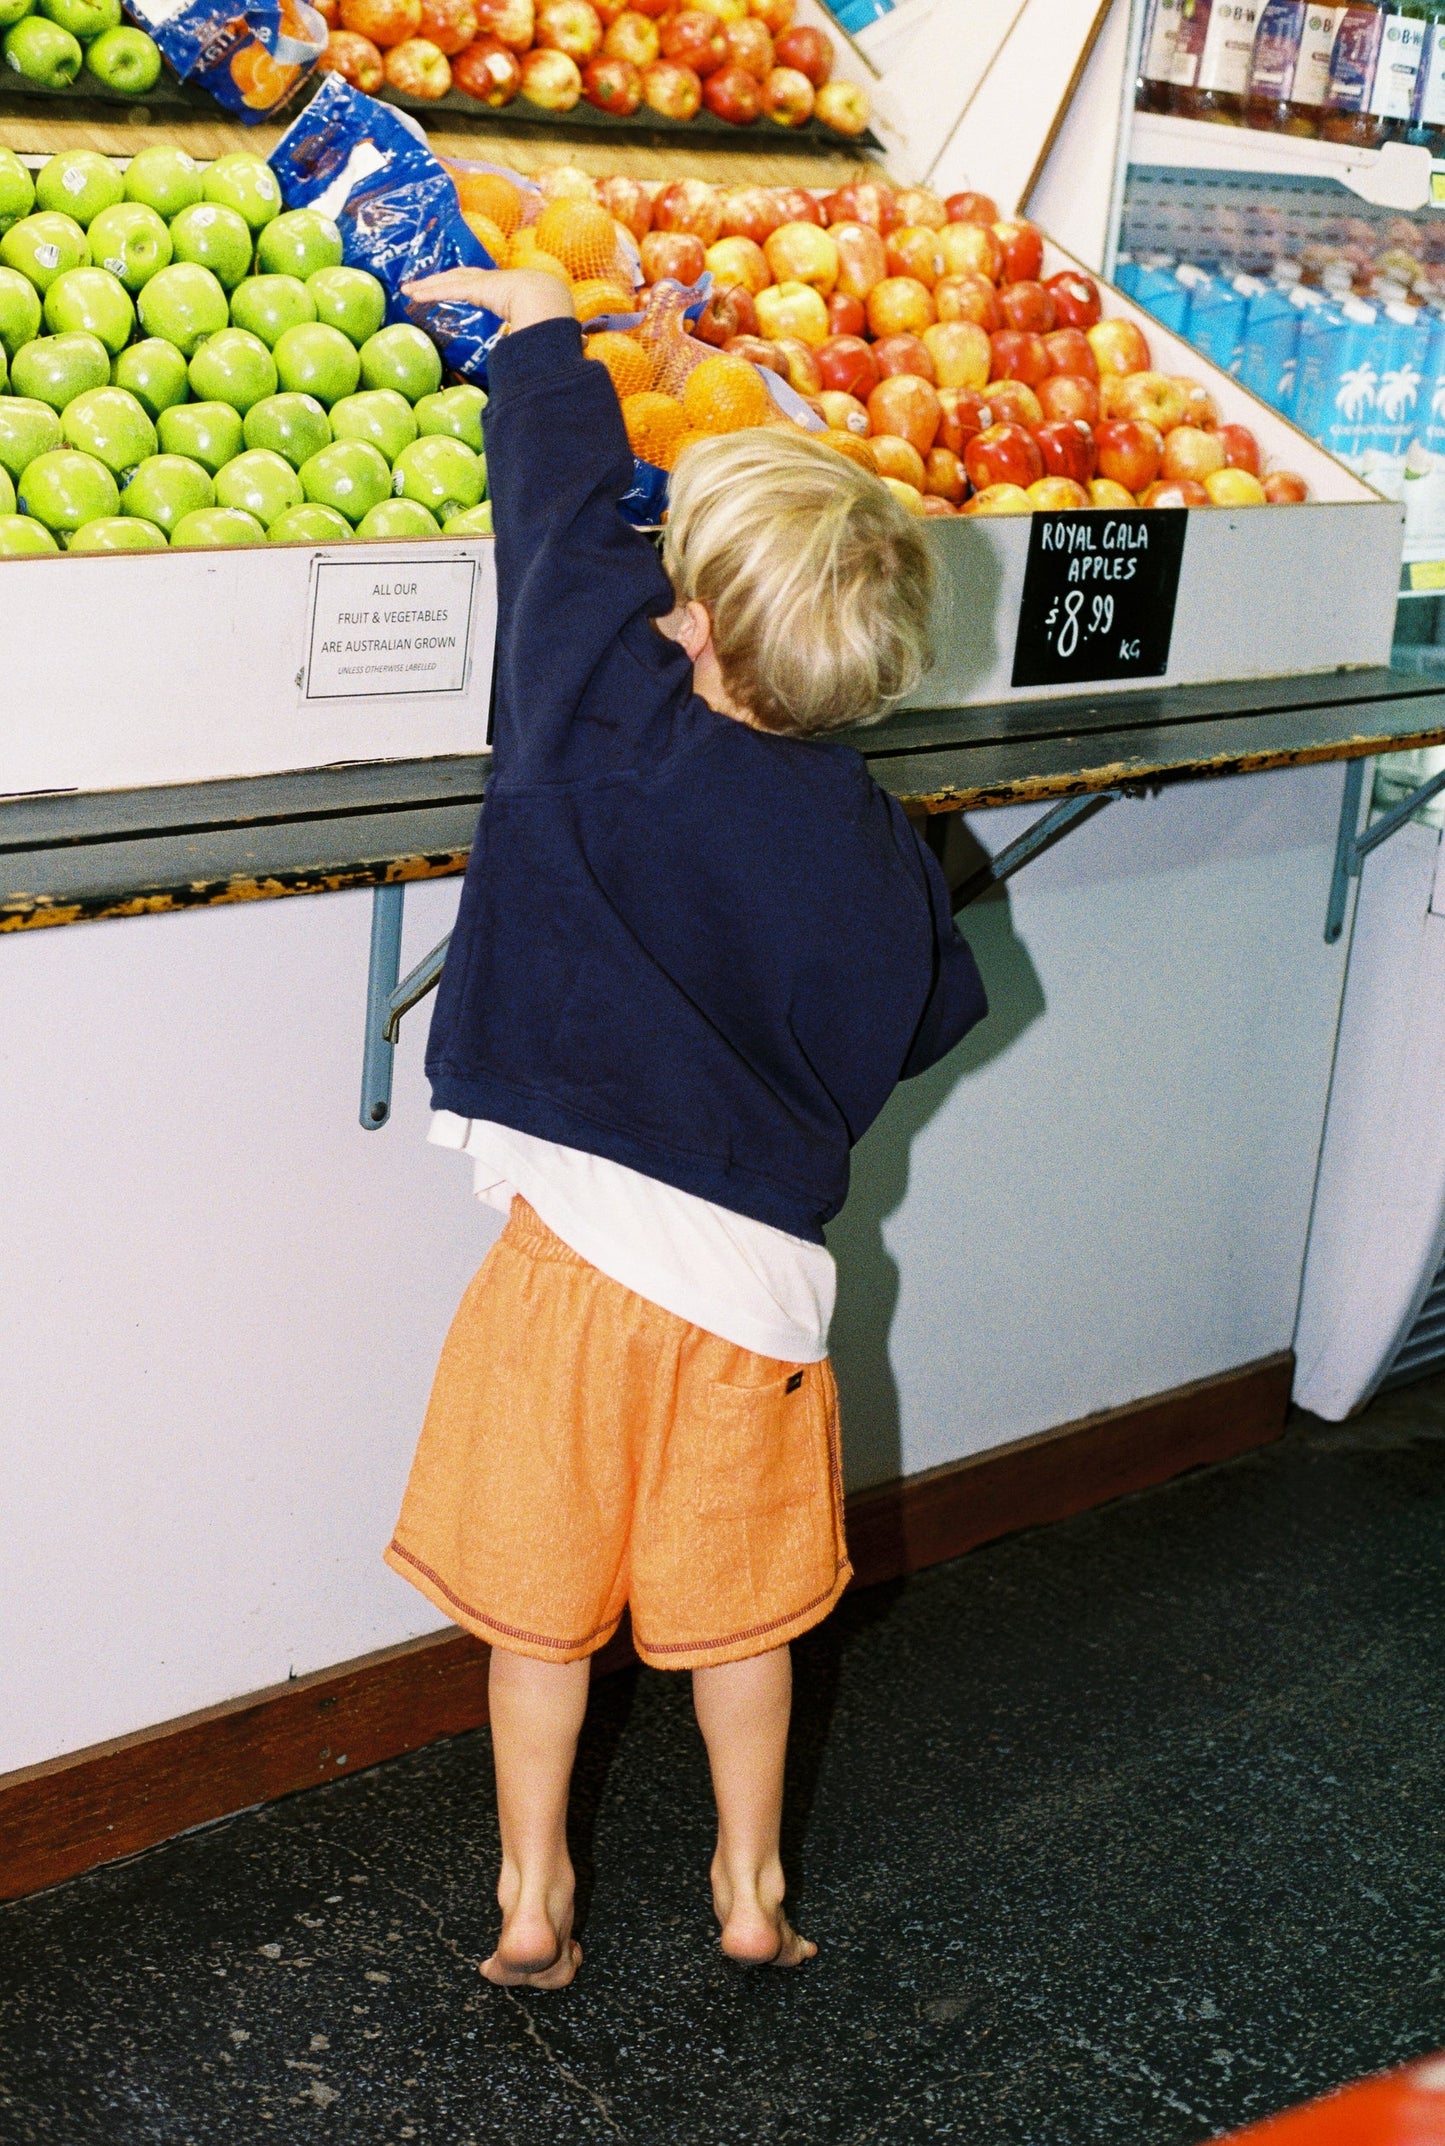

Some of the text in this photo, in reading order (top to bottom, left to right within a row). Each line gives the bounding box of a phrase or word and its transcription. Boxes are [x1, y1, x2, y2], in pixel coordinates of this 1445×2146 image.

[1042, 521, 1149, 554] ROYAL GALA
[1068, 556, 1137, 582] APPLES
[372, 583, 417, 596] ALL OUR
[338, 609, 448, 624] FRUIT & VEGETABLES
[321, 636, 456, 653] ARE AUSTRALIAN GROWN
[1119, 639, 1141, 660] KG
[338, 662, 437, 675] UNLESS OTHERWISE LABELLED
